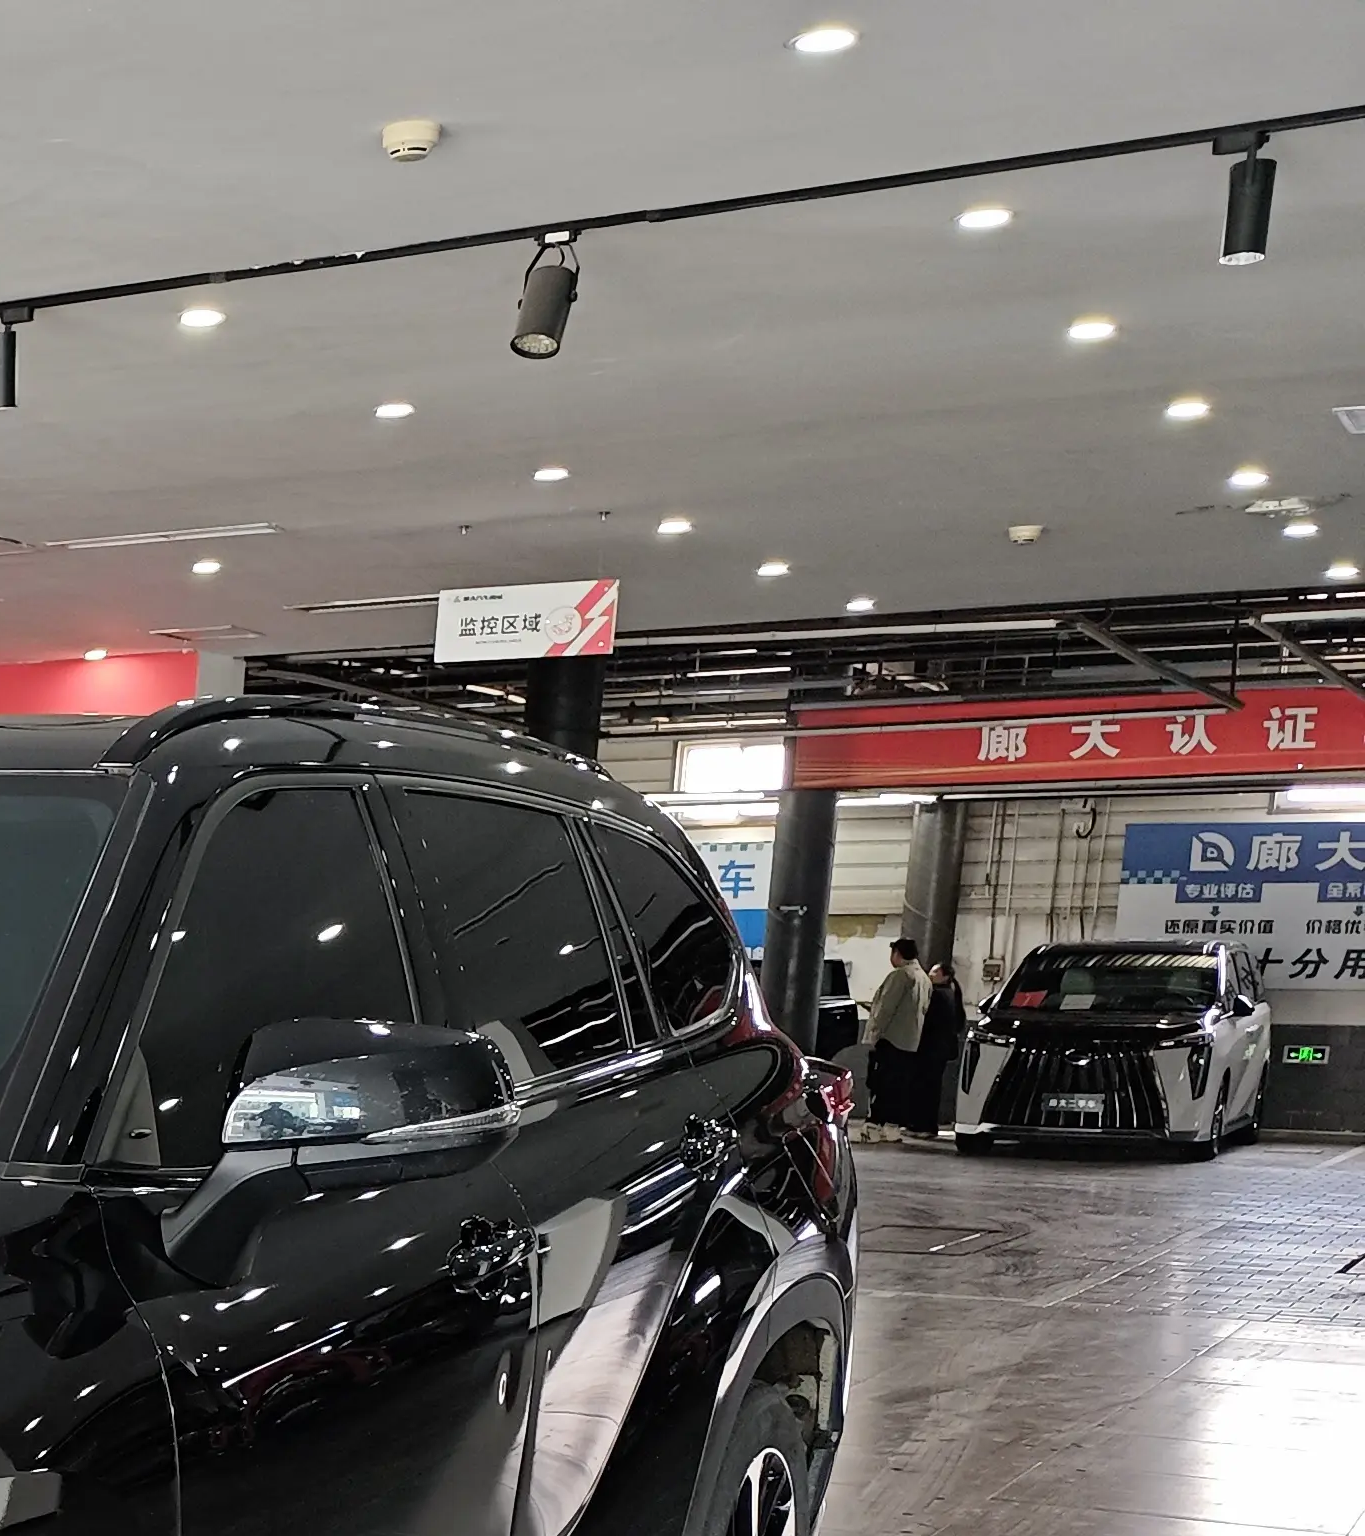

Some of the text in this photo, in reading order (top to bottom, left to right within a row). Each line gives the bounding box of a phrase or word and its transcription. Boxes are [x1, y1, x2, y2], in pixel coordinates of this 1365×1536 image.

[459, 613, 541, 637] 监控区域
[977, 706, 1318, 761] 廊大认证
[718, 860, 756, 899] 车
[1185, 882, 1365, 899] 专业评估 全系
[1165, 919, 1365, 935] 还原真实价值 价格优
